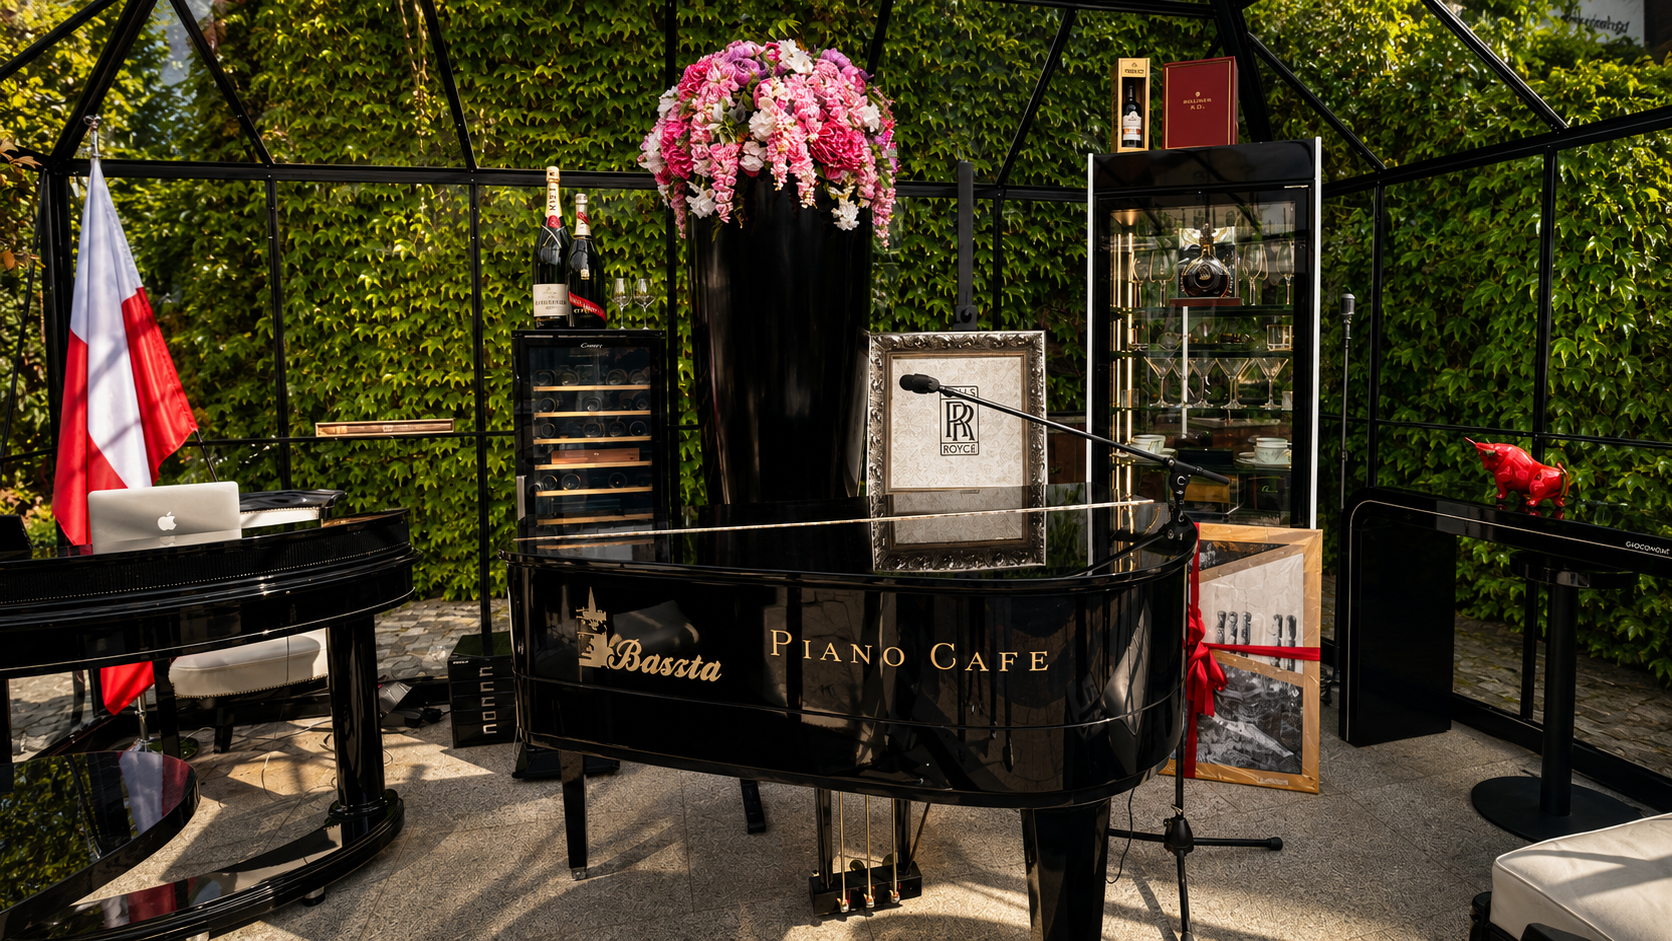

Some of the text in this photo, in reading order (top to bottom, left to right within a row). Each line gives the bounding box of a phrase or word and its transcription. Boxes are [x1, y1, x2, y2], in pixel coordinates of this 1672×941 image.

[946, 401, 975, 441] RR
[943, 444, 976, 454] ROYCE
[607, 638, 722, 682] Baszta
[770, 629, 1049, 672] PIANO CAFE
